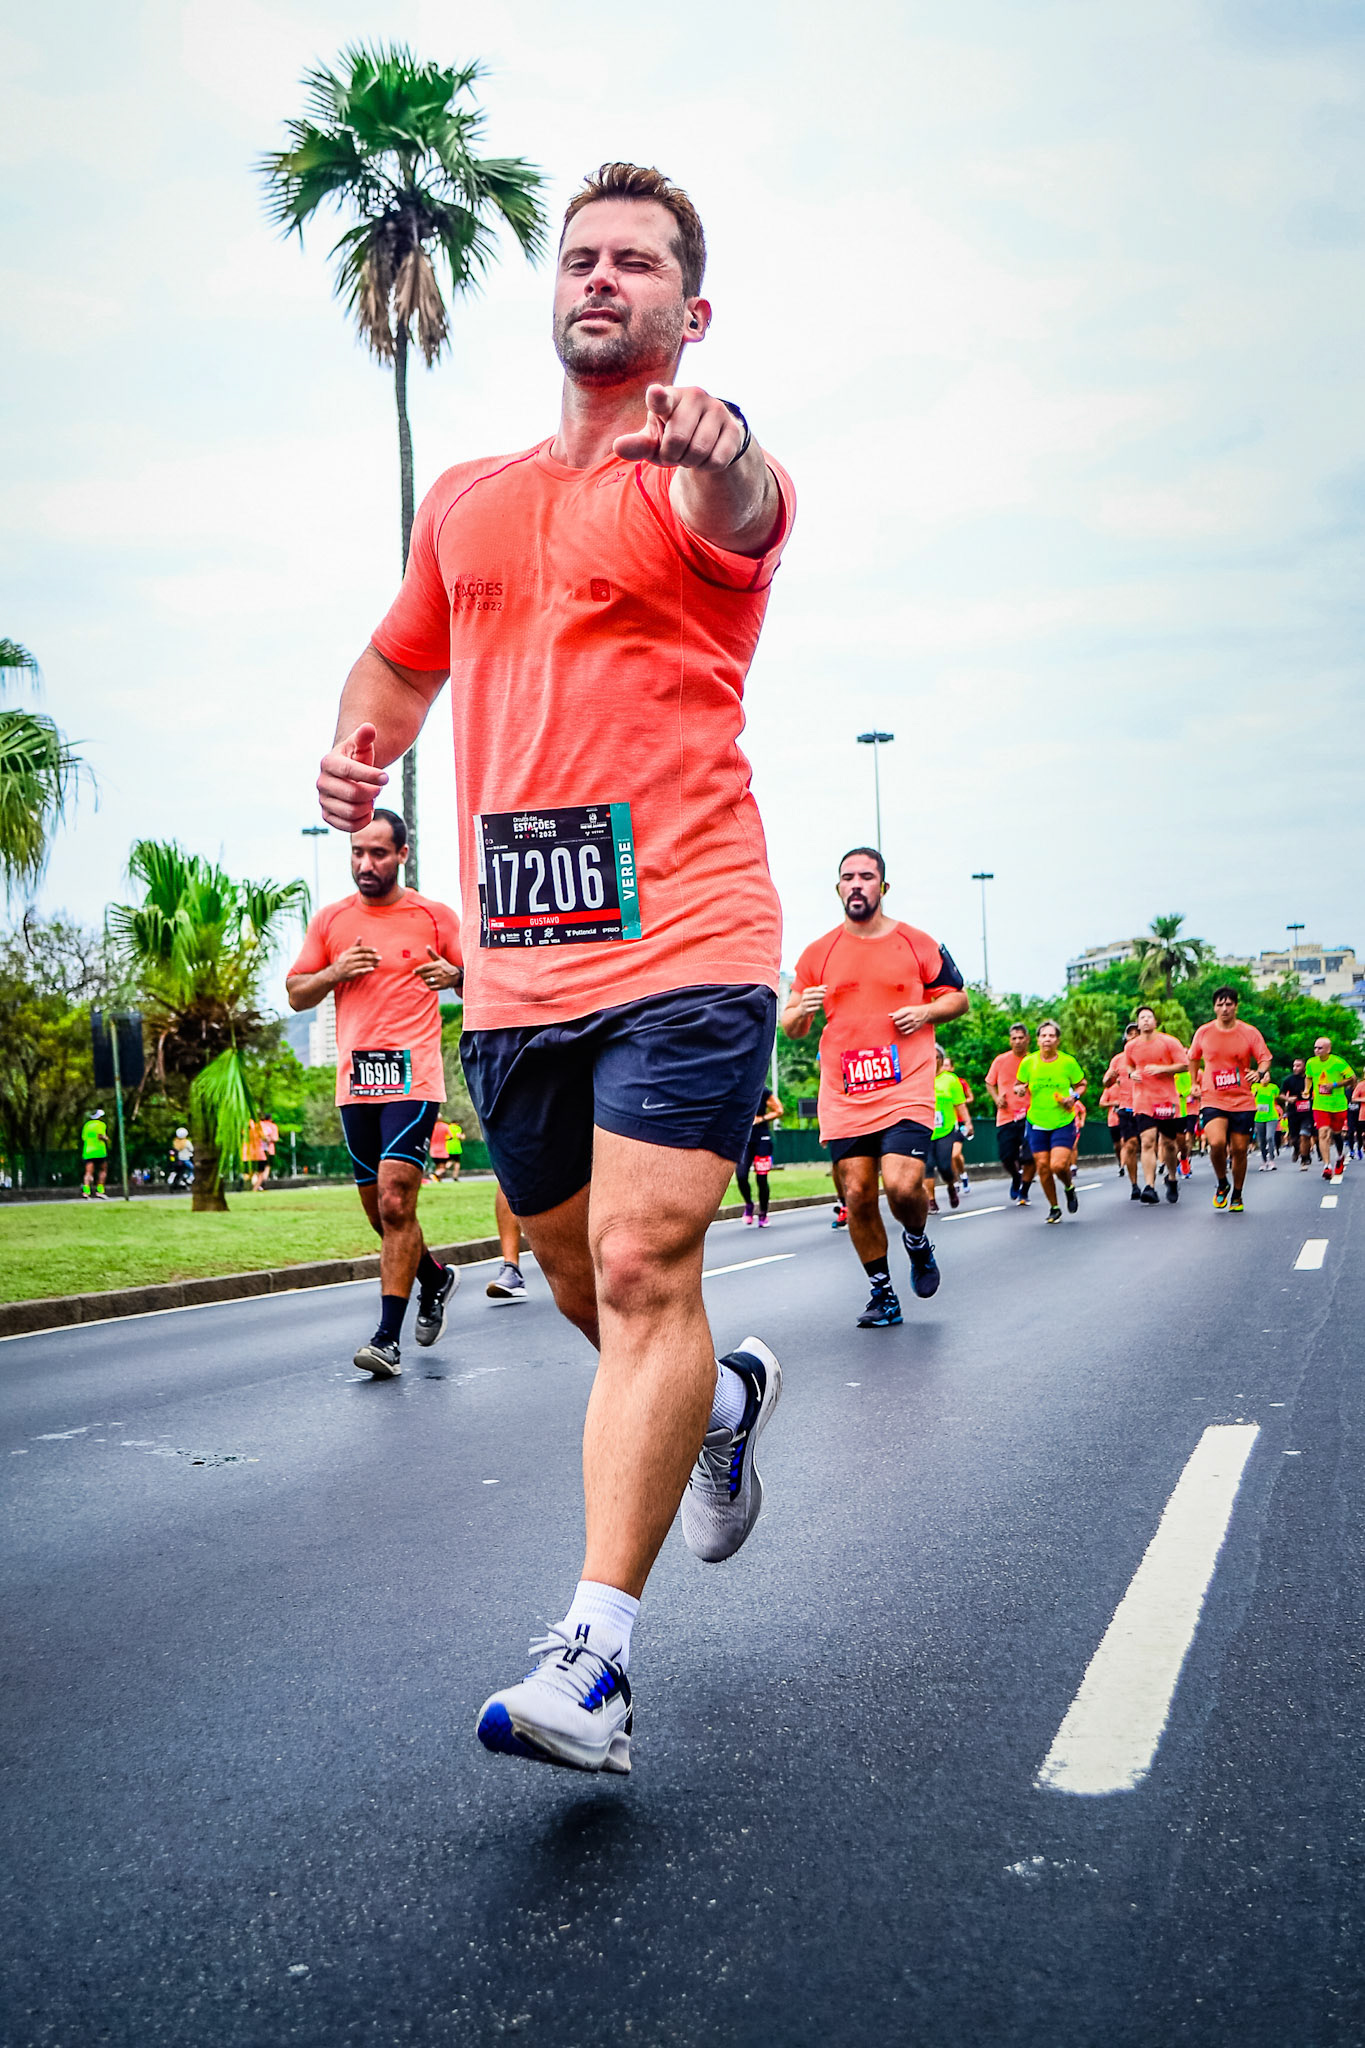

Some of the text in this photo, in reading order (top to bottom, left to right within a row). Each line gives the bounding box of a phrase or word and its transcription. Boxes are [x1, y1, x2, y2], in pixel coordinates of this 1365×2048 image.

[477, 601, 502, 611] 2022
[514, 819, 556, 832] ESTAÇÕES
[539, 830, 557, 838] 2022
[618, 842, 635, 900] VERDE
[492, 845, 605, 915] 17206
[530, 916, 559, 926] GUSTAVO
[602, 926, 620, 934] PRIO
[358, 1062, 400, 1085] 16916
[848, 1056, 891, 1083] 14053
